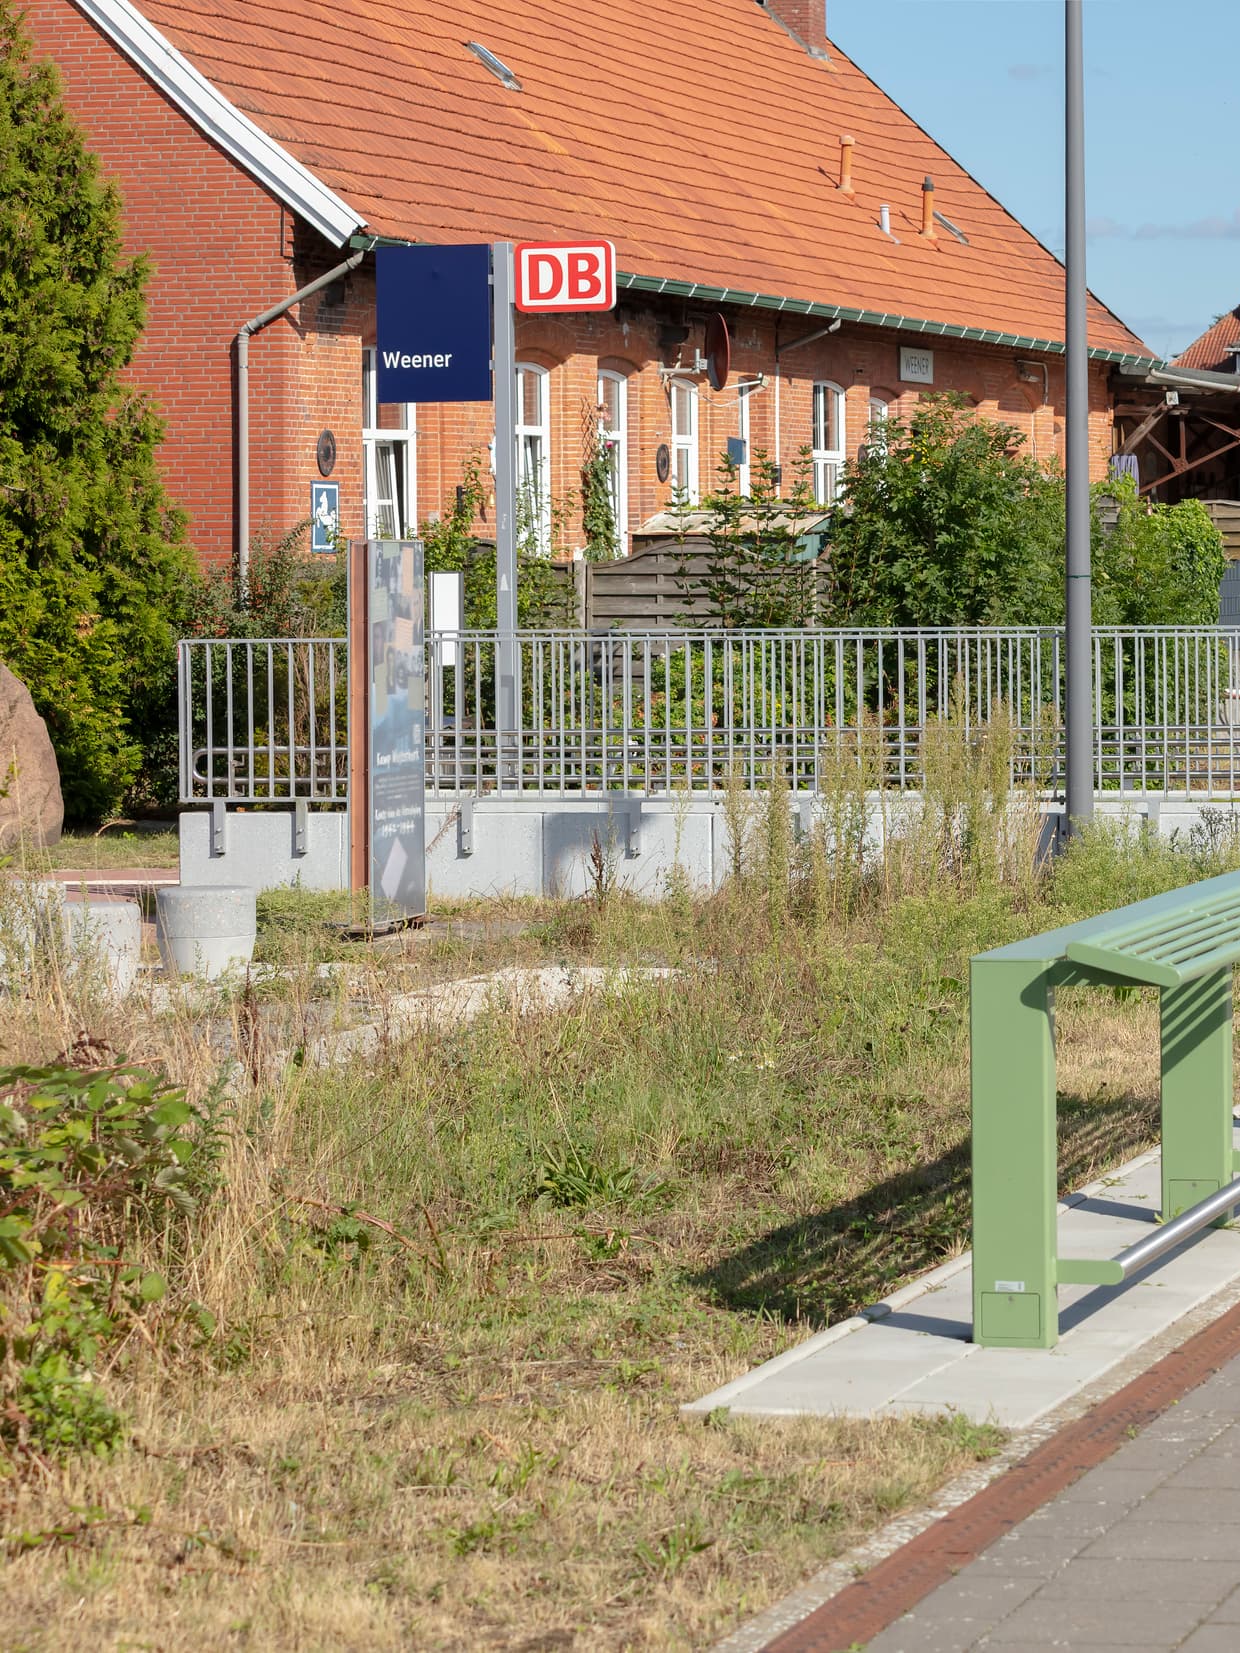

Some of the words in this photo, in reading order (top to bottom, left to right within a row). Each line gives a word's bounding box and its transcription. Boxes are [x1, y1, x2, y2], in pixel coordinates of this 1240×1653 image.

[528, 252, 602, 301] DB
[382, 351, 452, 369] Weener
[904, 355, 929, 376] WEENER
